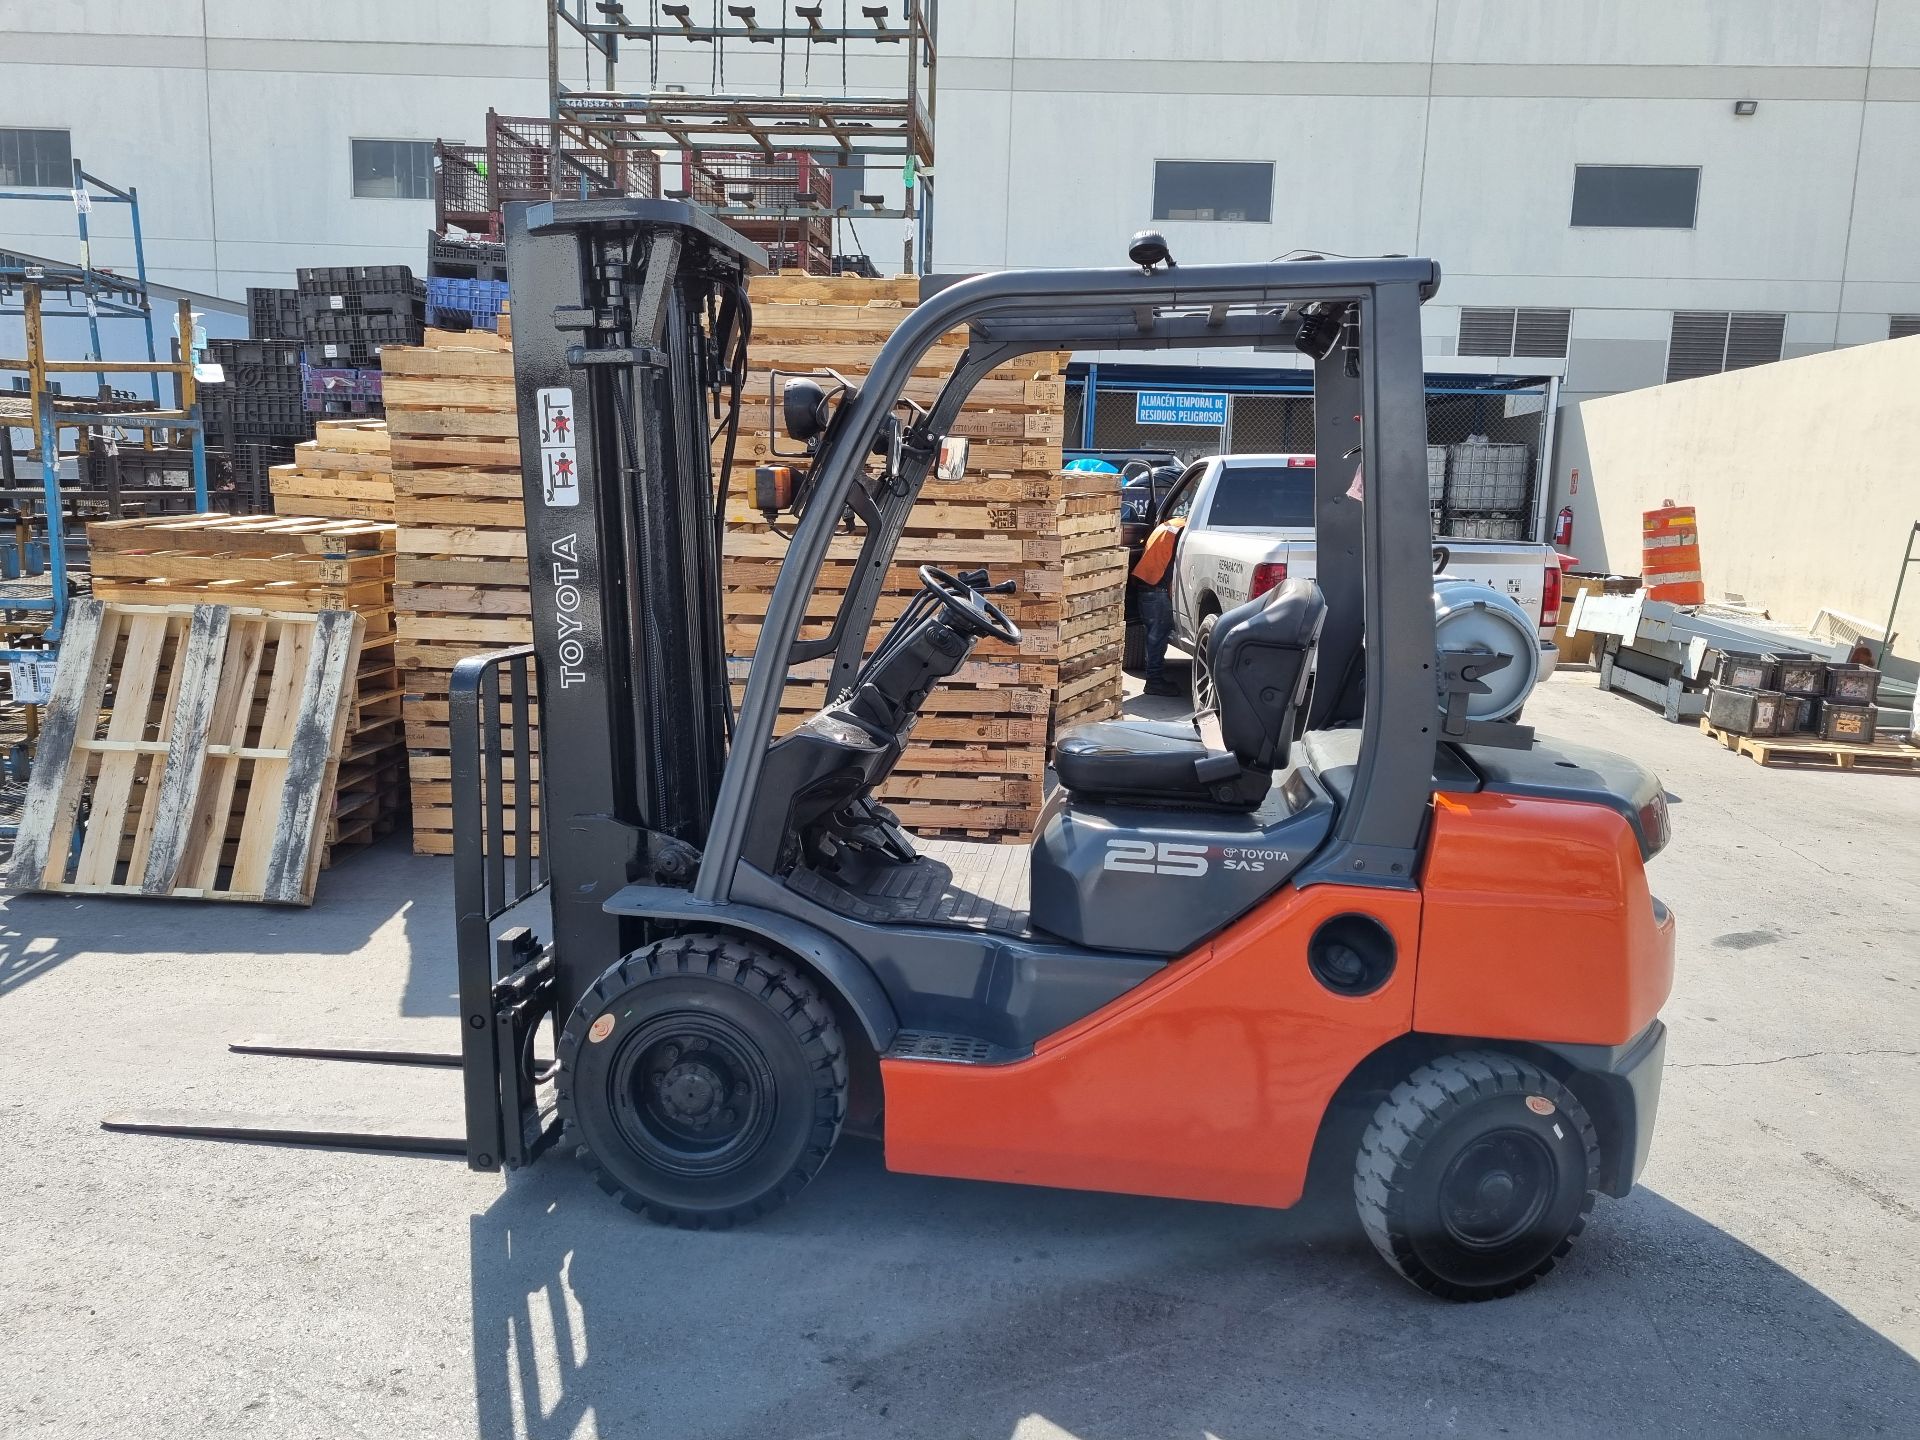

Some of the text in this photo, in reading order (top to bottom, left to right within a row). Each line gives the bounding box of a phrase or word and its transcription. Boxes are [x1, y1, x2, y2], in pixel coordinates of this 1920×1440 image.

[1141, 394, 1223, 409] ALMACÉN TEMPORAL DE
[1140, 409, 1223, 423] RESIDUOS PELIGROSOS
[552, 533, 586, 689] TOYOTA
[1104, 839, 1209, 877] 25
[1240, 848, 1289, 862] TOYOTA
[1223, 860, 1266, 872] SAS
